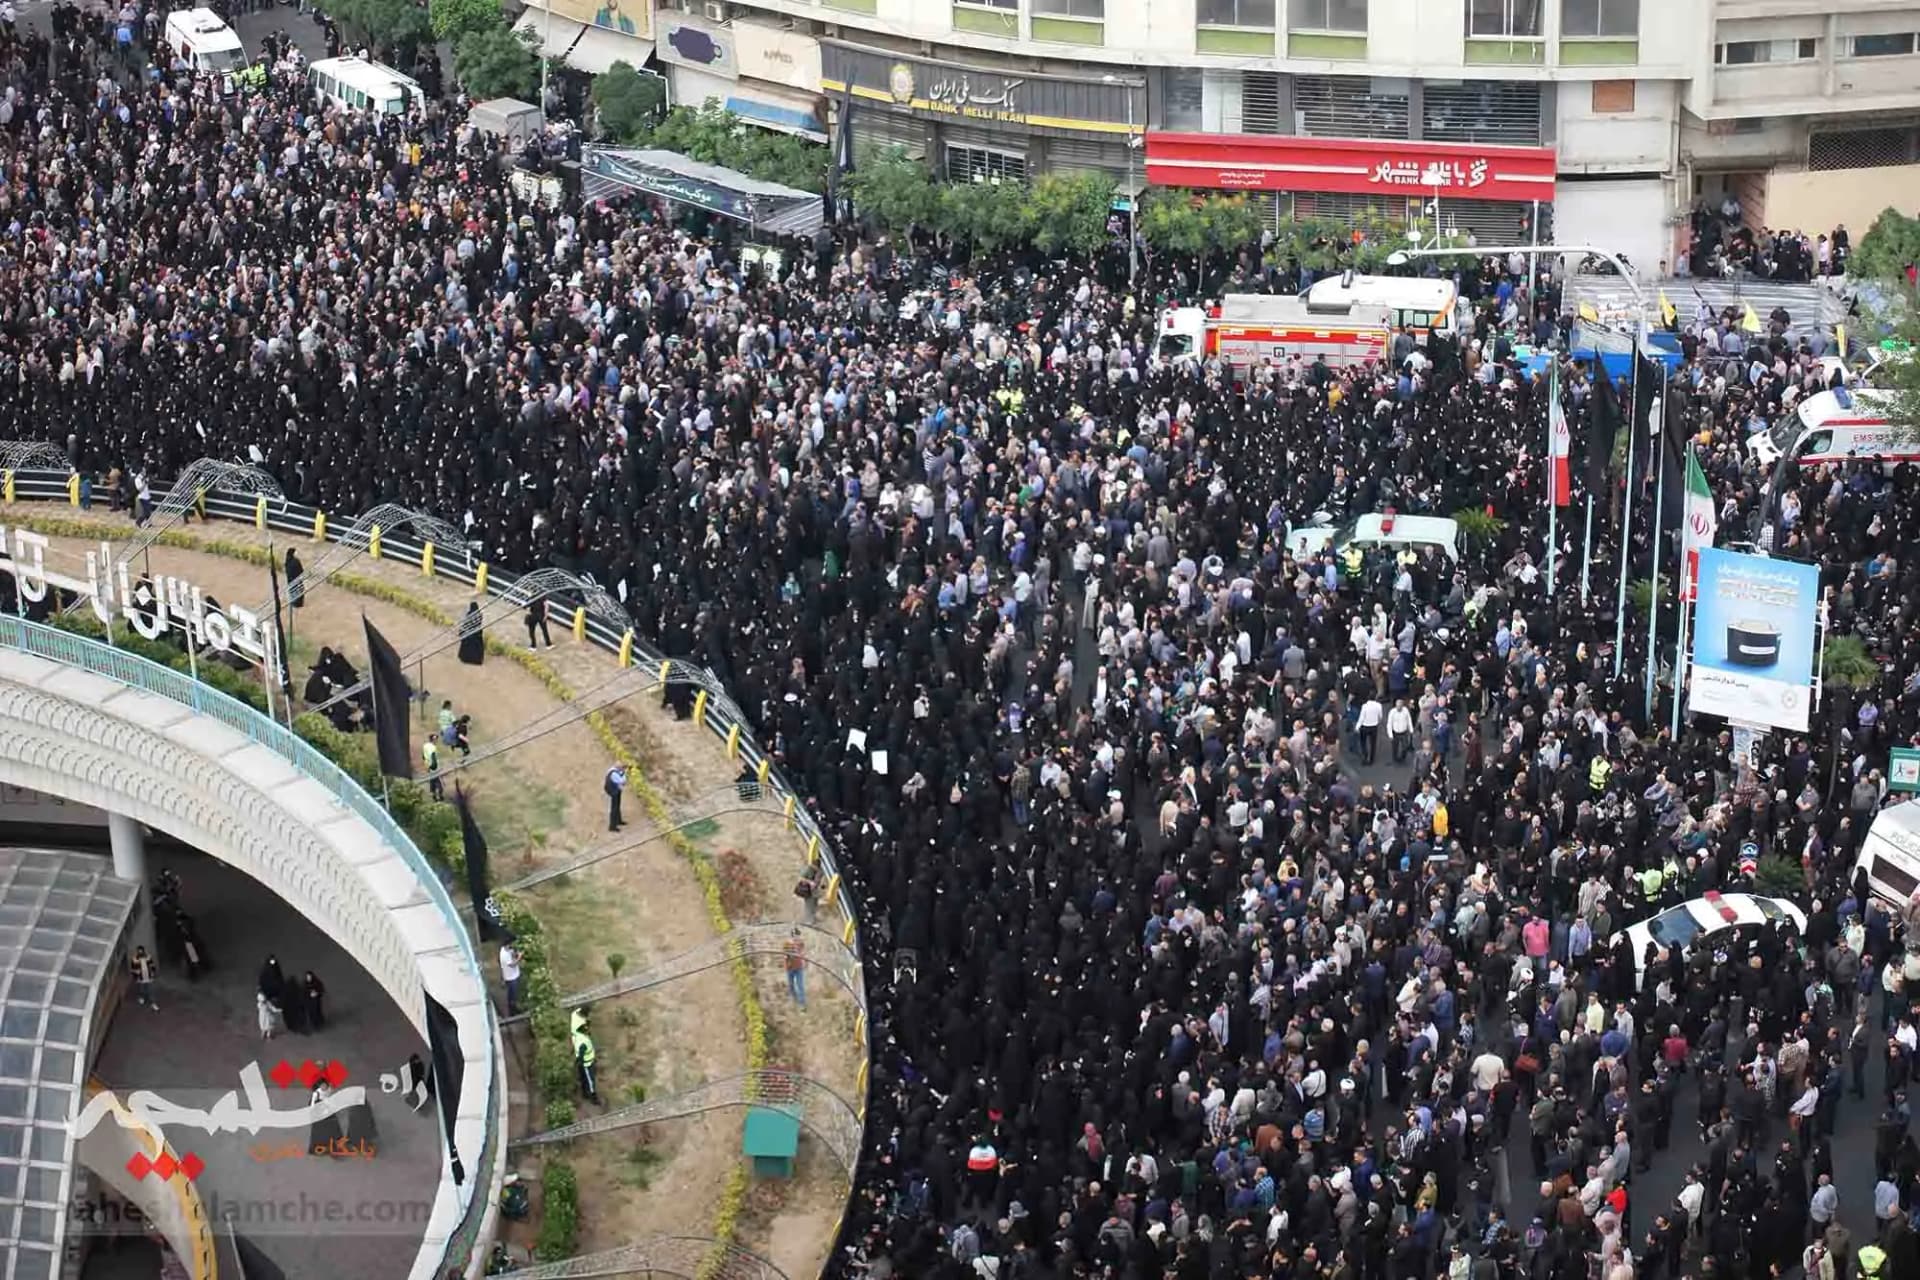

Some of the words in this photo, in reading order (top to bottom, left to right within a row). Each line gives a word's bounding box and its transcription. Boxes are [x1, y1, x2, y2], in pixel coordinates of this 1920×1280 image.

[929, 79, 956, 103] ایران
[969, 79, 1024, 112] بانک
[930, 102, 959, 113] BANK
[963, 106, 993, 119] MELLI
[997, 110, 1025, 123] IRAN
[1368, 160, 1419, 184] شهر
[1394, 176, 1419, 185] BANK
[1853, 433, 1873, 442] EMS
